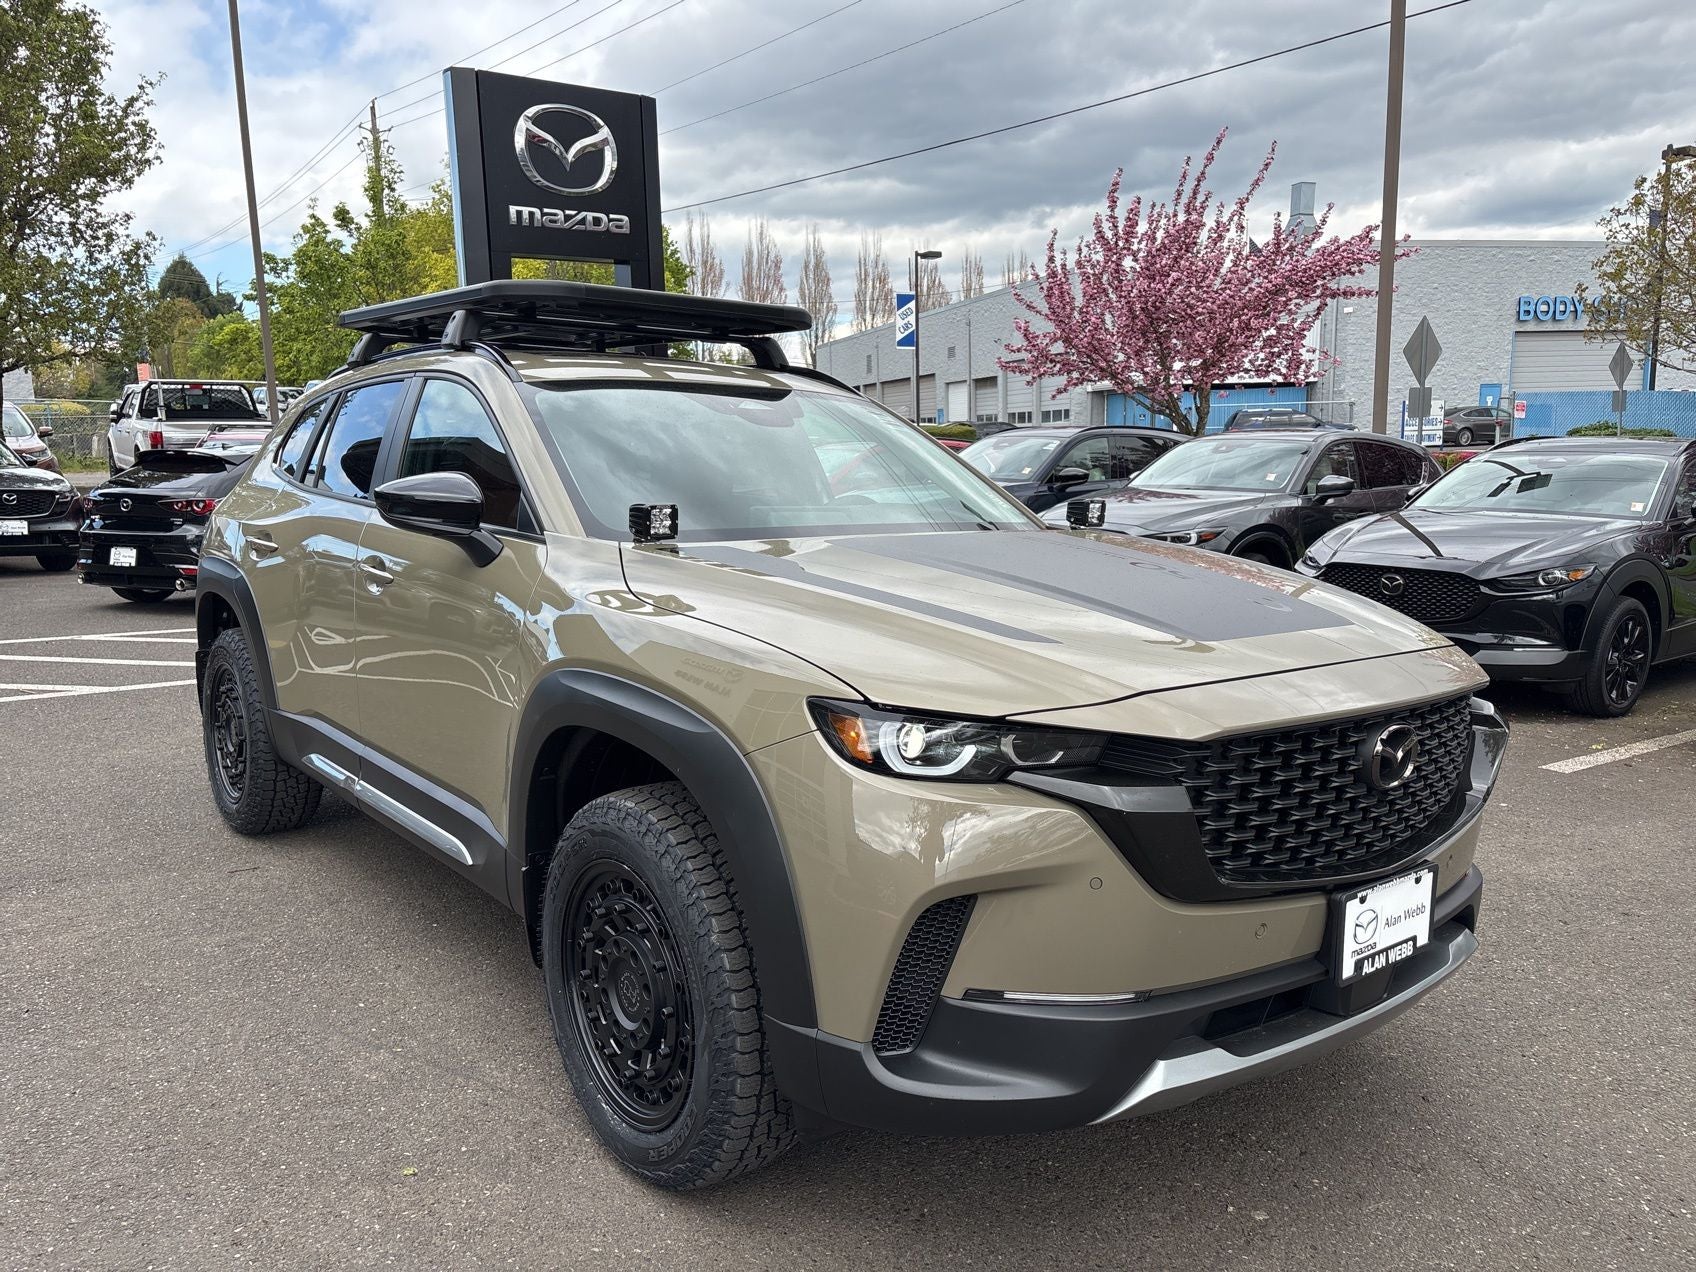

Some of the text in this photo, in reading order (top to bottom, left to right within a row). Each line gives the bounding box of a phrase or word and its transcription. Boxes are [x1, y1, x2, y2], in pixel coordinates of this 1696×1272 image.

[508, 204, 631, 234] mazda
[898, 307, 914, 321] USED
[1518, 296, 1585, 321] BODY
[898, 320, 914, 335] CARS
[1383, 902, 1426, 930] Alan Webb
[1362, 940, 1414, 976] ALAN WEBB
